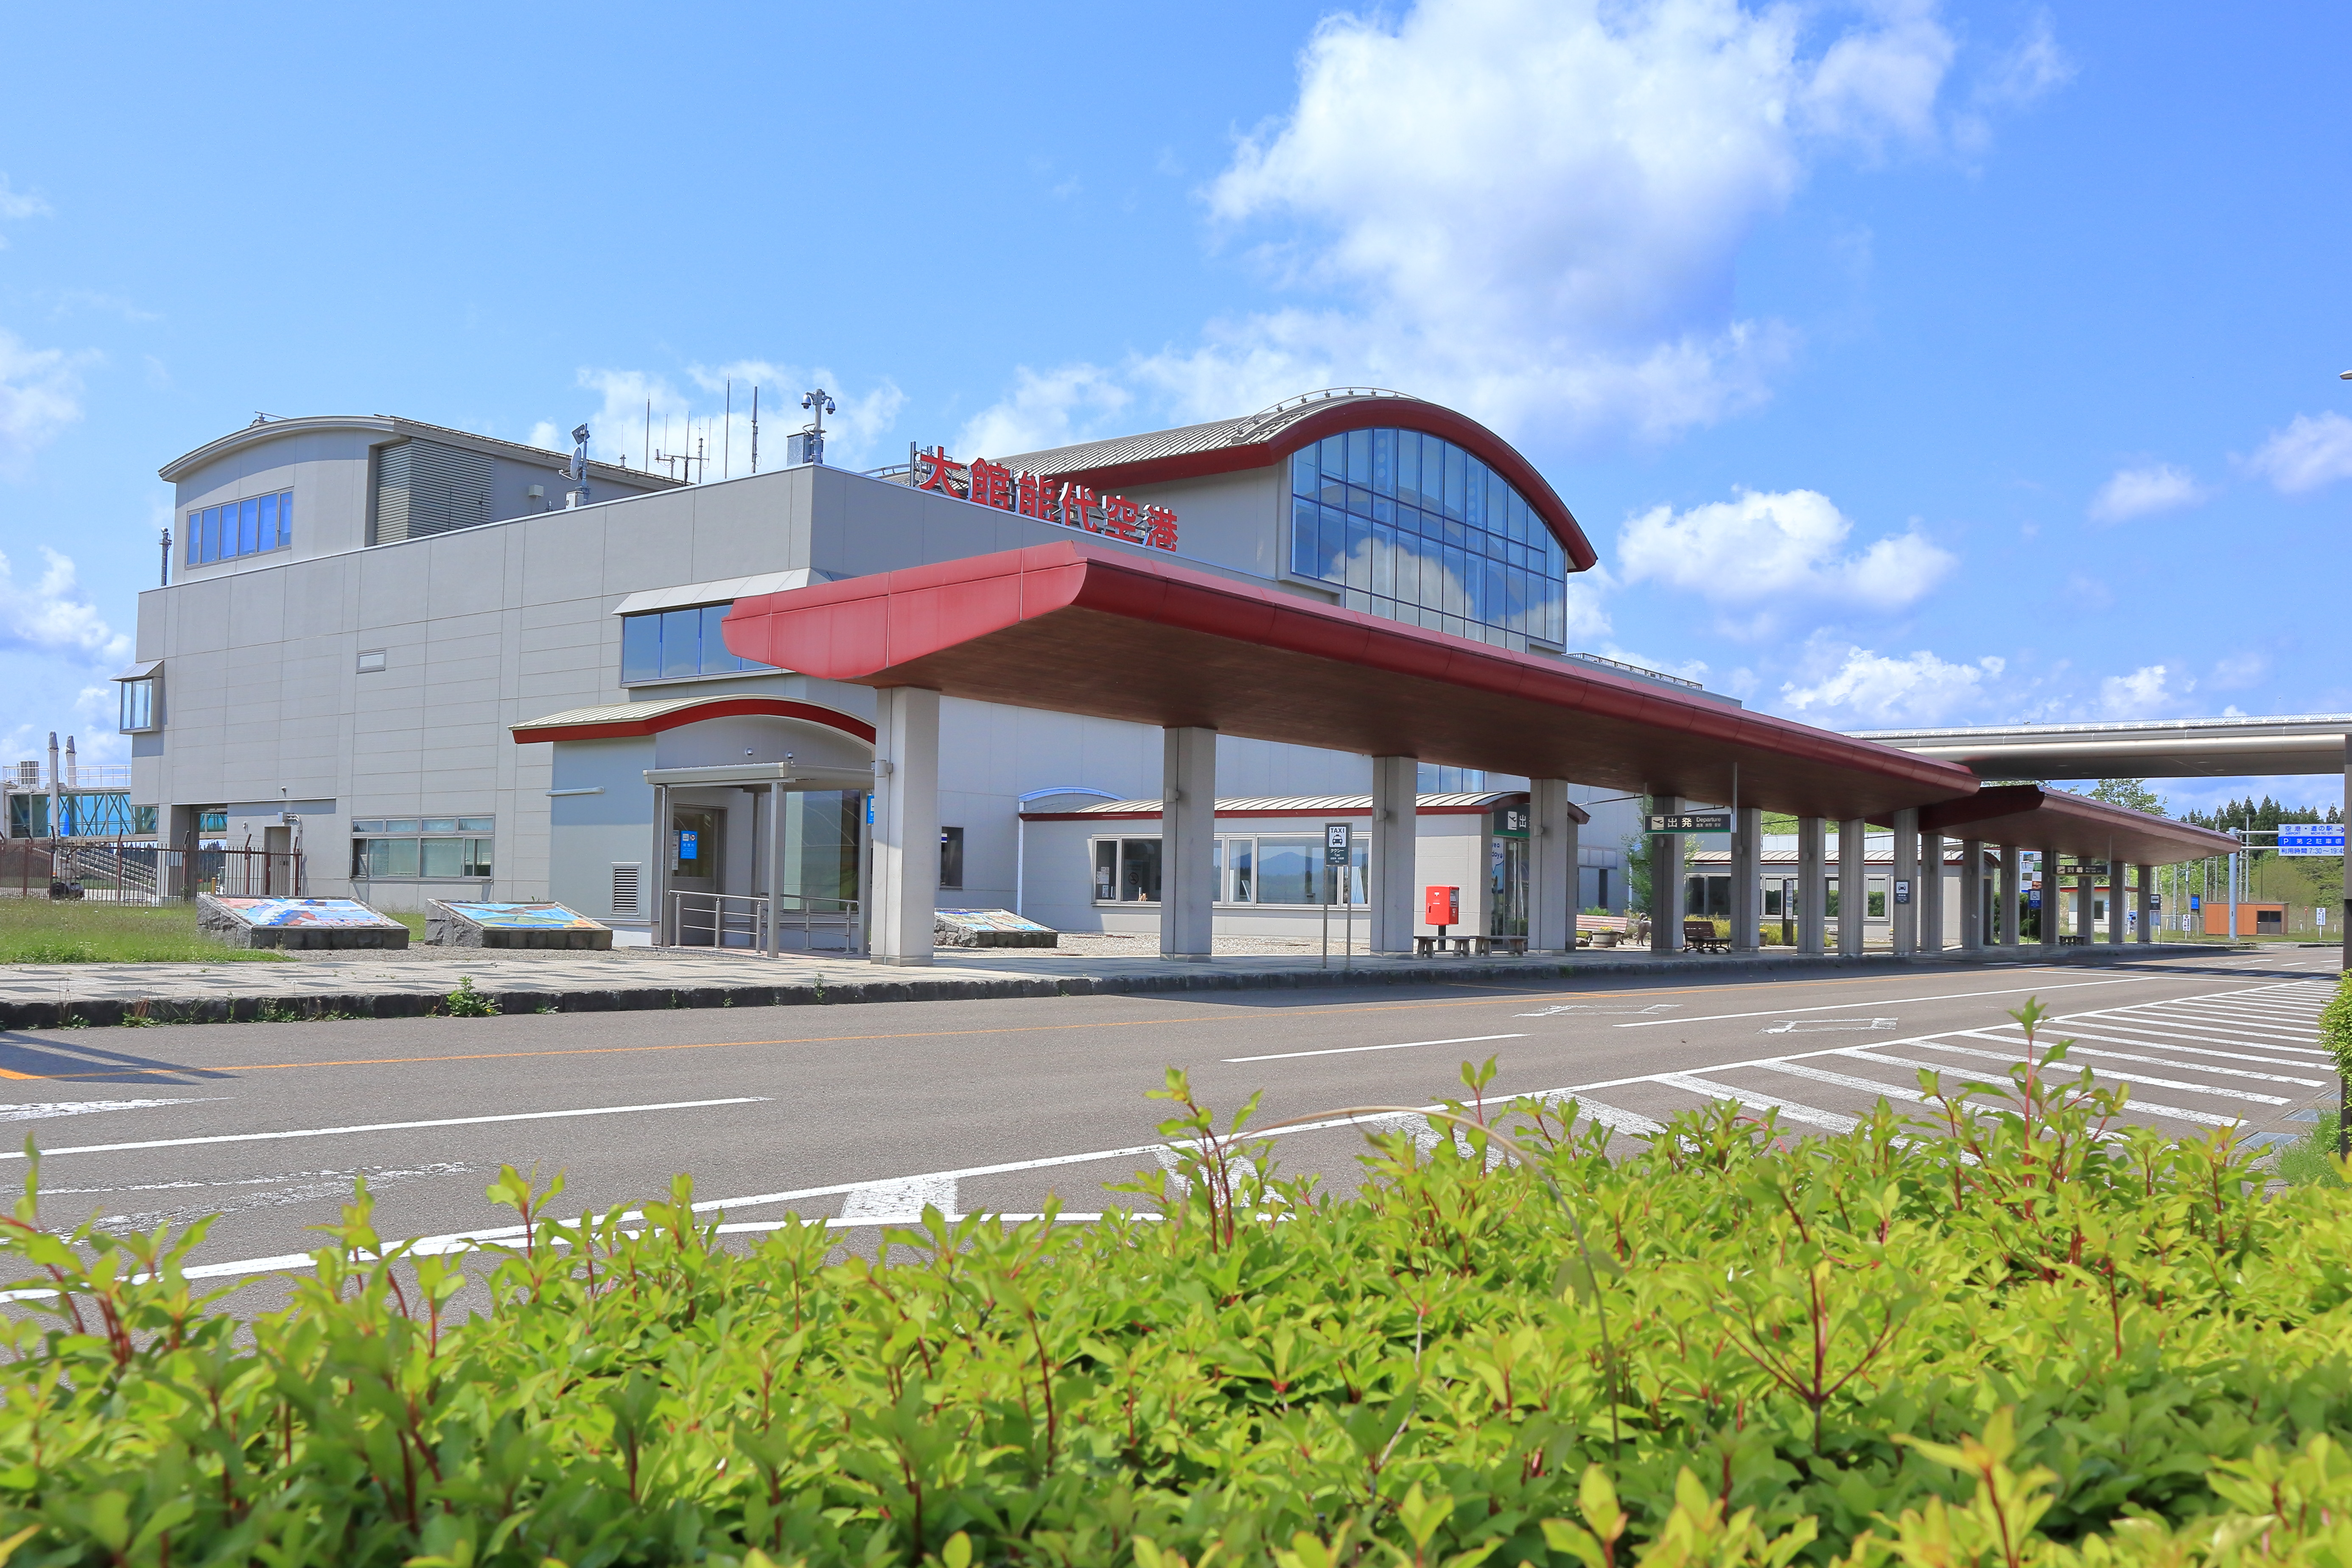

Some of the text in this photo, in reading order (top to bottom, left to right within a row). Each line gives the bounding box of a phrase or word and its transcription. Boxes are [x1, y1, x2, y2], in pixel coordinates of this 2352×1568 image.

[918, 445, 1179, 552] 大館能代空港
[1519, 814, 1530, 828] 出
[1668, 817, 1692, 828] 出発
